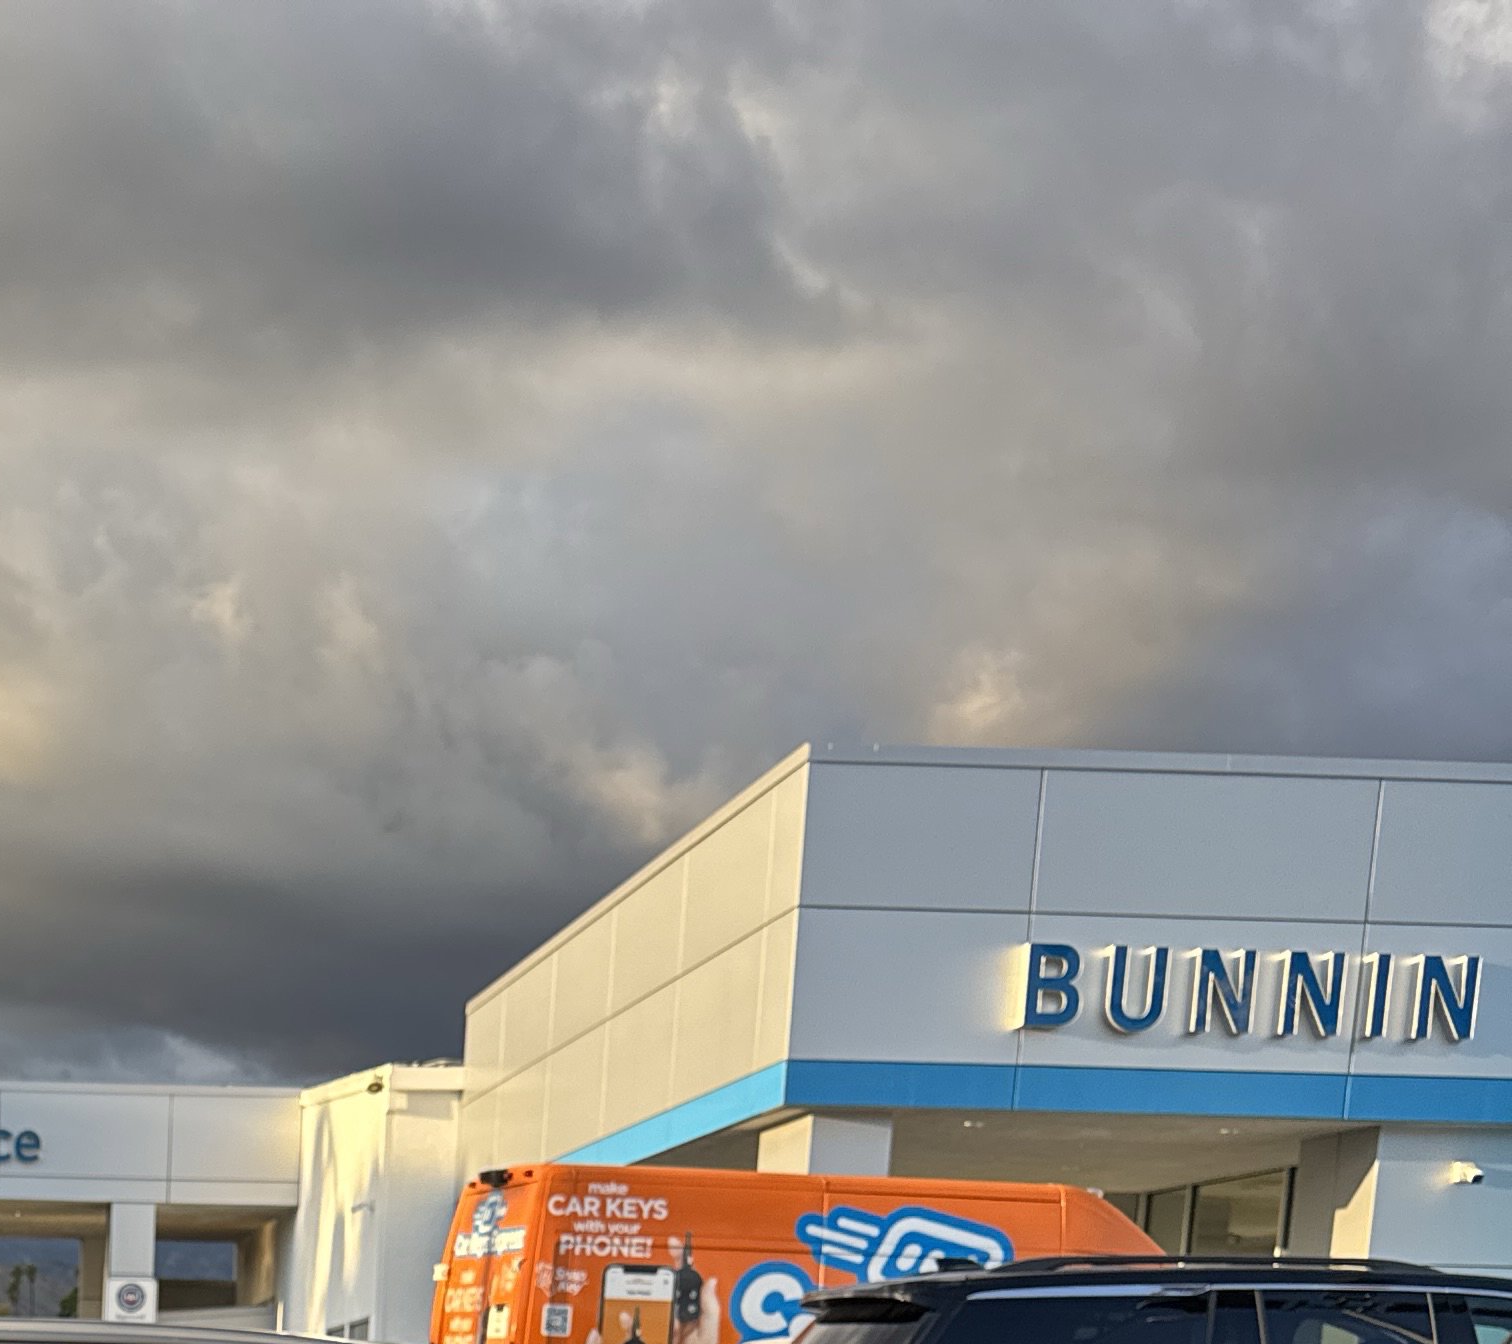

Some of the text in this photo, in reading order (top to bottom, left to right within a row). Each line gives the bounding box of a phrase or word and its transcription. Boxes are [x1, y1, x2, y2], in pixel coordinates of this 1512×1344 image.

[1021, 942, 1483, 1040] BUNNIN
[588, 1182, 629, 1196] make
[547, 1194, 669, 1221] CAR KEYS
[573, 1219, 641, 1235] with your
[558, 1233, 654, 1258] PHONE!
